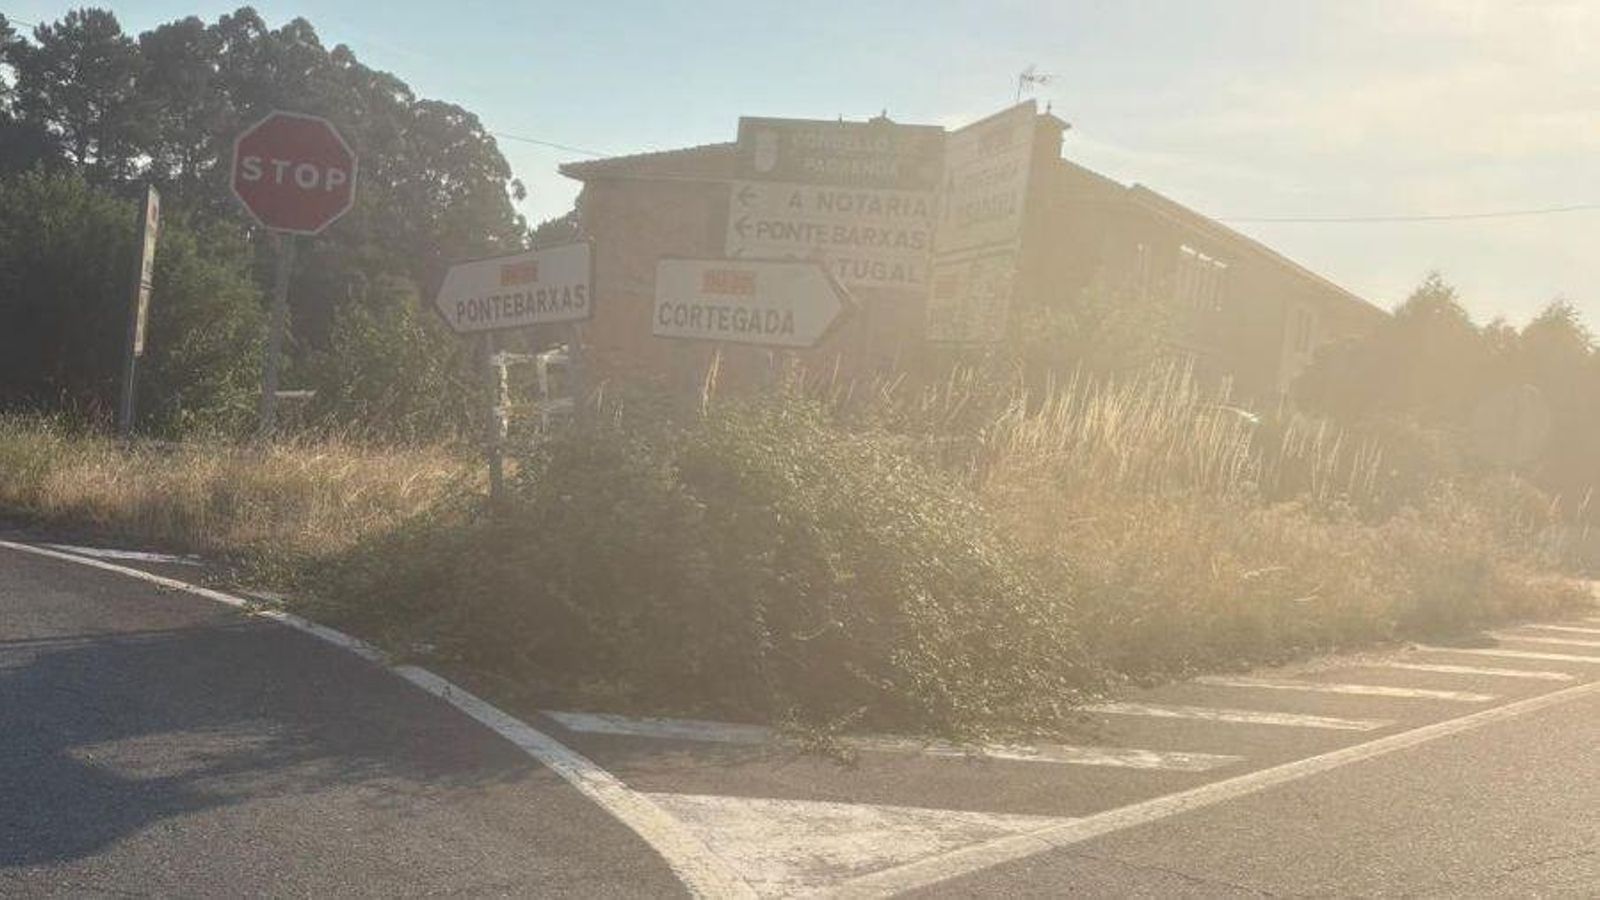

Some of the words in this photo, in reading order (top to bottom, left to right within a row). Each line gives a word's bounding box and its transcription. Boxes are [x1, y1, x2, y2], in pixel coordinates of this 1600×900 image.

[241, 156, 347, 191] STOP
[787, 191, 803, 209] A
[816, 191, 929, 217] NOTARIA
[756, 222, 927, 251] PONTEBARXAS
[834, 258, 921, 284] TUGAL
[456, 284, 587, 325] PONTEBARXAS
[658, 302, 796, 336] CORTEGADA
